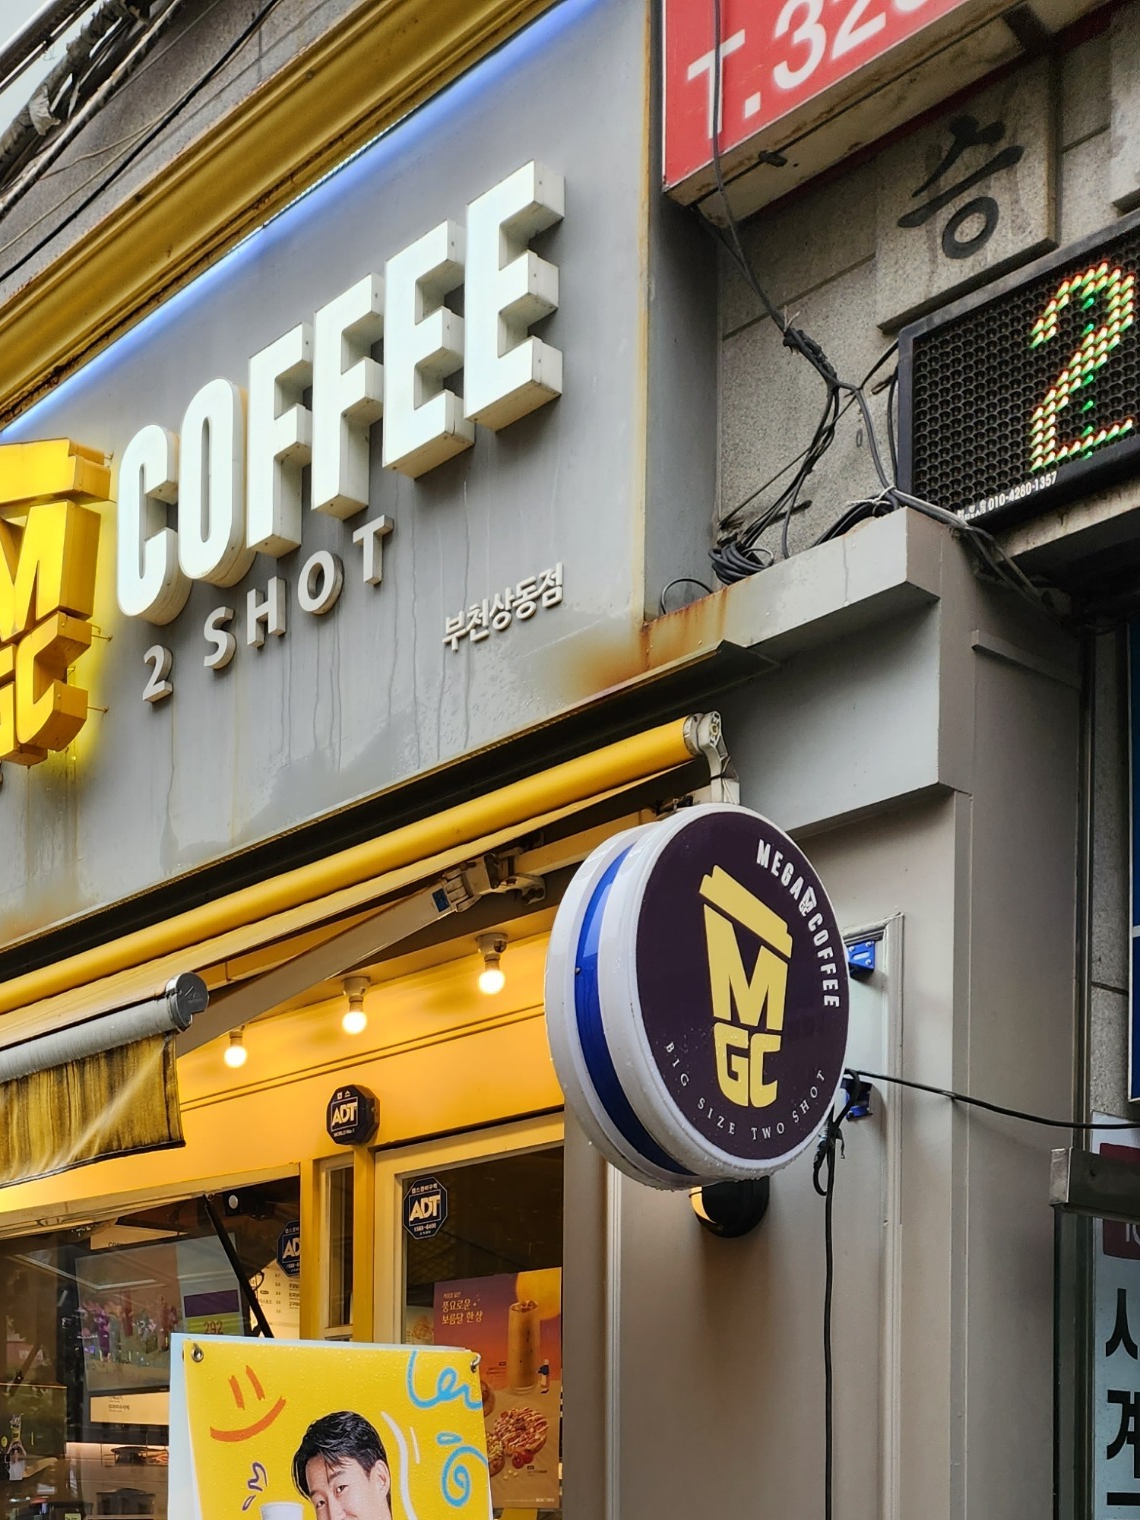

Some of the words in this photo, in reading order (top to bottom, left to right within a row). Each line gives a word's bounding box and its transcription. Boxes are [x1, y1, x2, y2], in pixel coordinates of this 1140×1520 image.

[117, 160, 564, 626] COFFEE
[143, 644, 174, 704] 2
[203, 514, 394, 672] SHOT
[442, 561, 566, 652] 부천상동점
[756, 838, 801, 903] MEGA
[806, 911, 841, 1010] COFFEE
[331, 1101, 358, 1127] ADT
[664, 1041, 690, 1088] BIG
[697, 1099, 737, 1137] SIZE
[751, 1121, 786, 1142] TWO
[791, 1069, 826, 1125] SHOT
[282, 1236, 300, 1260] AD
[408, 1195, 441, 1222] ADT
[441, 1298, 472, 1313] 풍요로운
